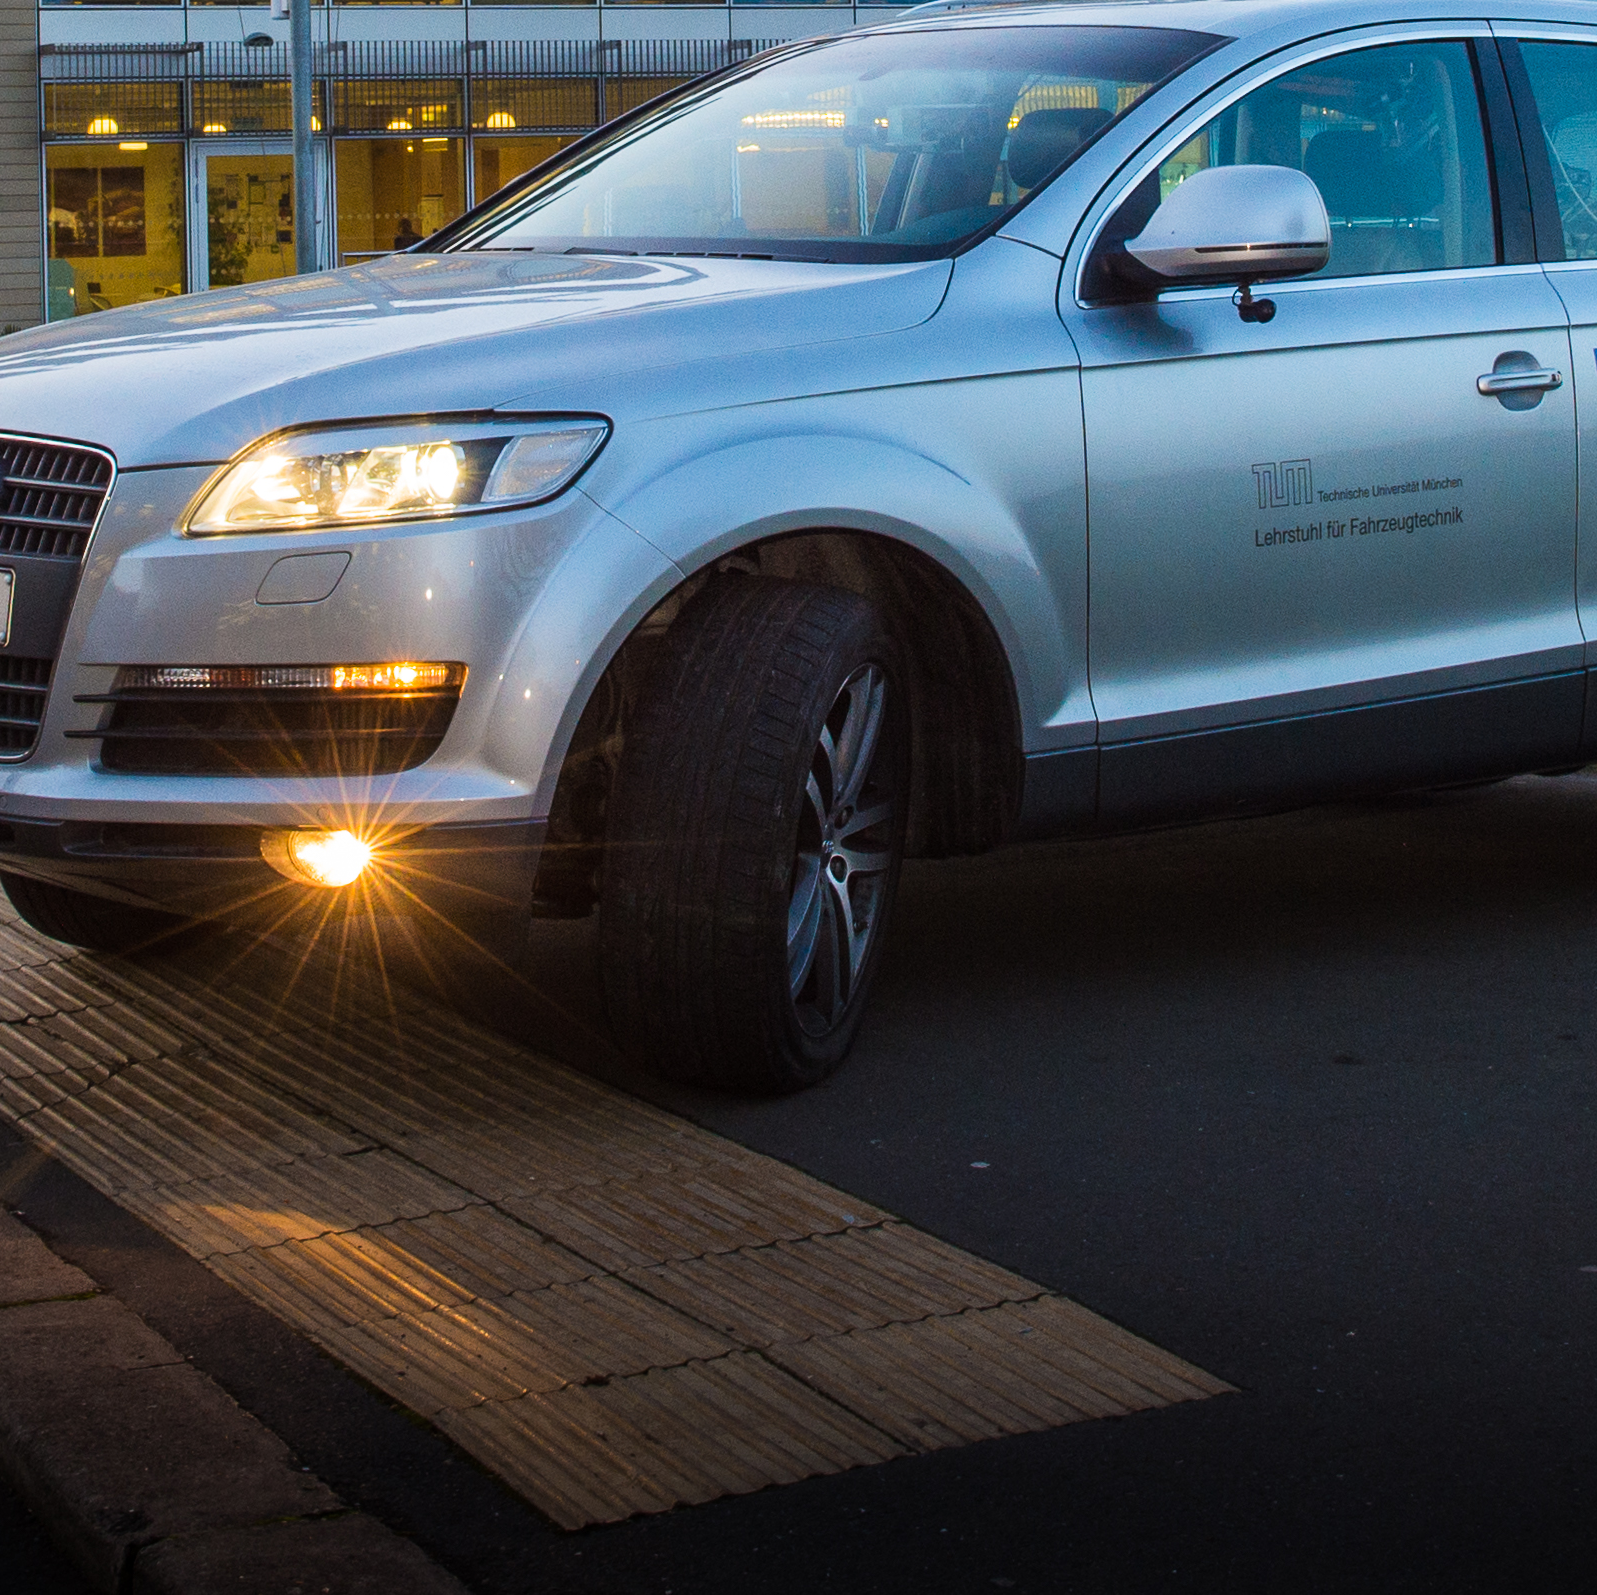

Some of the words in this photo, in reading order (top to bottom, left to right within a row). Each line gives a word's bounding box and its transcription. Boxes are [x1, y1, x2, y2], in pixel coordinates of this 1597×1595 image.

[1251, 458, 1313, 509] TUM
[1317, 489, 1370, 502] Technische
[1372, 481, 1420, 497] Universität
[1421, 476, 1464, 492] München
[1255, 523, 1322, 547] Lehrstuhl
[1327, 520, 1346, 538] für
[1349, 506, 1464, 535] Fahrzeugtechnik
